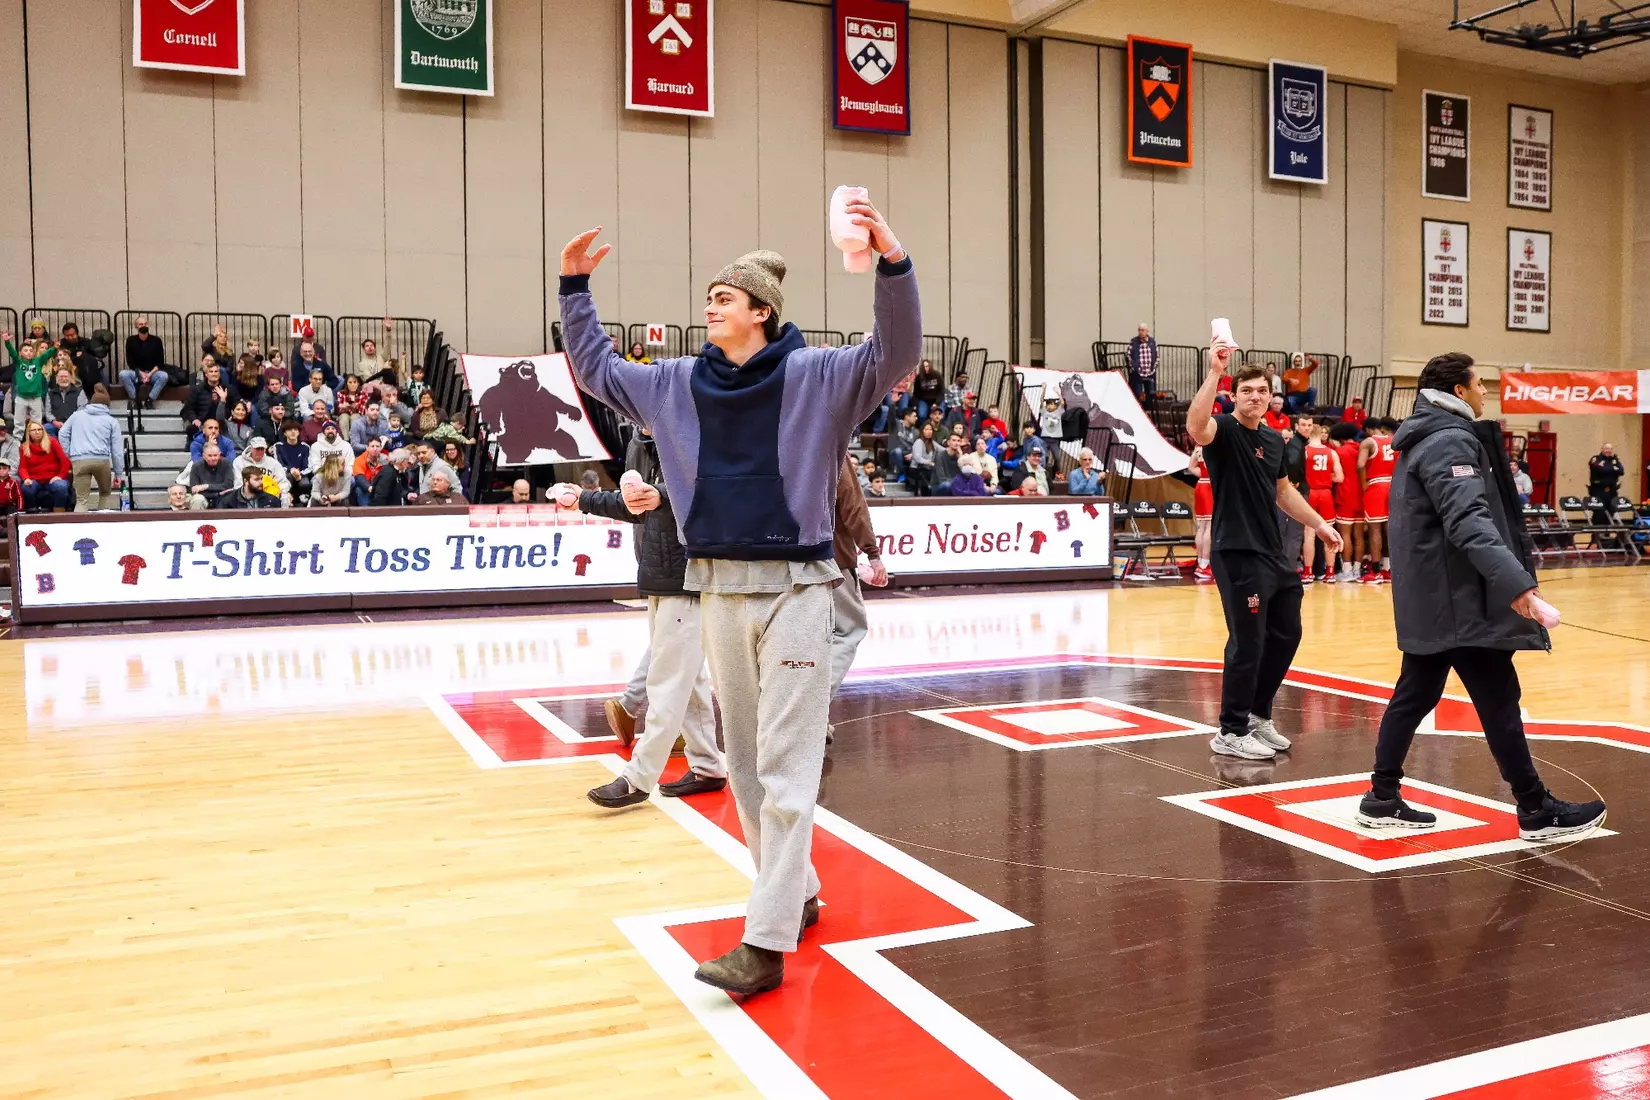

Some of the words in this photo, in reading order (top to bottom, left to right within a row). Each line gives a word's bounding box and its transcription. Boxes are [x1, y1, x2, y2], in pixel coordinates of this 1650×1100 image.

[163, 28, 217, 48] Cornell
[432, 25, 458, 36] 1769
[410, 50, 478, 74] Dartmouth
[647, 78, 694, 94] Harvard
[840, 96, 904, 114] Pennsylvania
[1140, 130, 1182, 148] Princeton
[1290, 150, 1308, 164] Yale
[1429, 144, 1466, 158] CHAMPIONS
[1513, 157, 1548, 170] CHAMPIONS
[1428, 273, 1463, 284] CHAMPIONS
[1512, 280, 1546, 290] CHAMPIONS
[293, 318, 310, 334] M
[650, 328, 662, 342] N
[1504, 385, 1634, 402] HIGHBAR
[1382, 444, 1395, 461] 12
[1312, 454, 1328, 471] 31
[924, 522, 1023, 554] Noise!
[162, 539, 324, 578] T-Shirt
[340, 538, 430, 574] Toss
[446, 532, 562, 570] Time!
